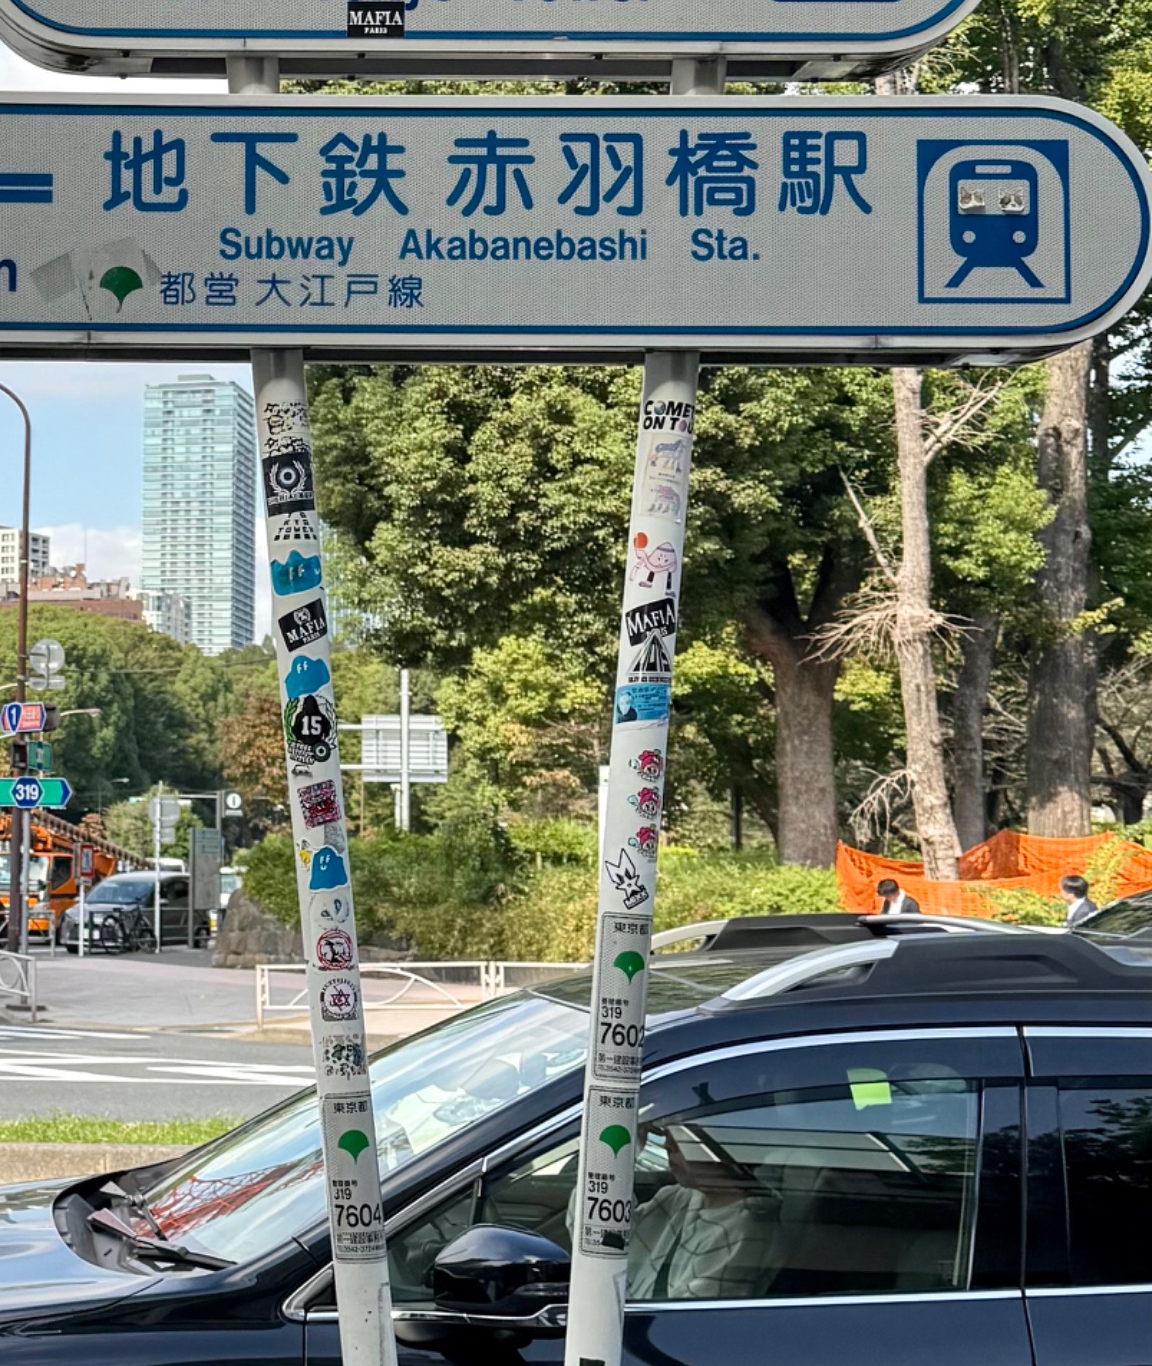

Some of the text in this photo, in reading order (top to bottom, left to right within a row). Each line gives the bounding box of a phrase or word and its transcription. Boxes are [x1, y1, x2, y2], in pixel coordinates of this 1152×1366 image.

[348, 10, 403, 26] MAFIA
[102, 129, 873, 217] 地下鉄赤羽橋駅
[218, 226, 761, 268] Subway Akabanebashi Sta.
[628, 602, 676, 636] MAFIA
[286, 616, 326, 644] MAFIA
[10, 706, 17, 725] 1
[301, 715, 323, 736] 15
[15, 783, 40, 801] 319
[614, 921, 649, 935] 東京都
[601, 1005, 622, 1019] 319
[333, 1100, 369, 1115] 東京都
[599, 1095, 635, 1109] 東京都
[334, 1187, 352, 1200] 319
[588, 1180, 609, 1194] 319
[334, 1202, 382, 1228] 7604
